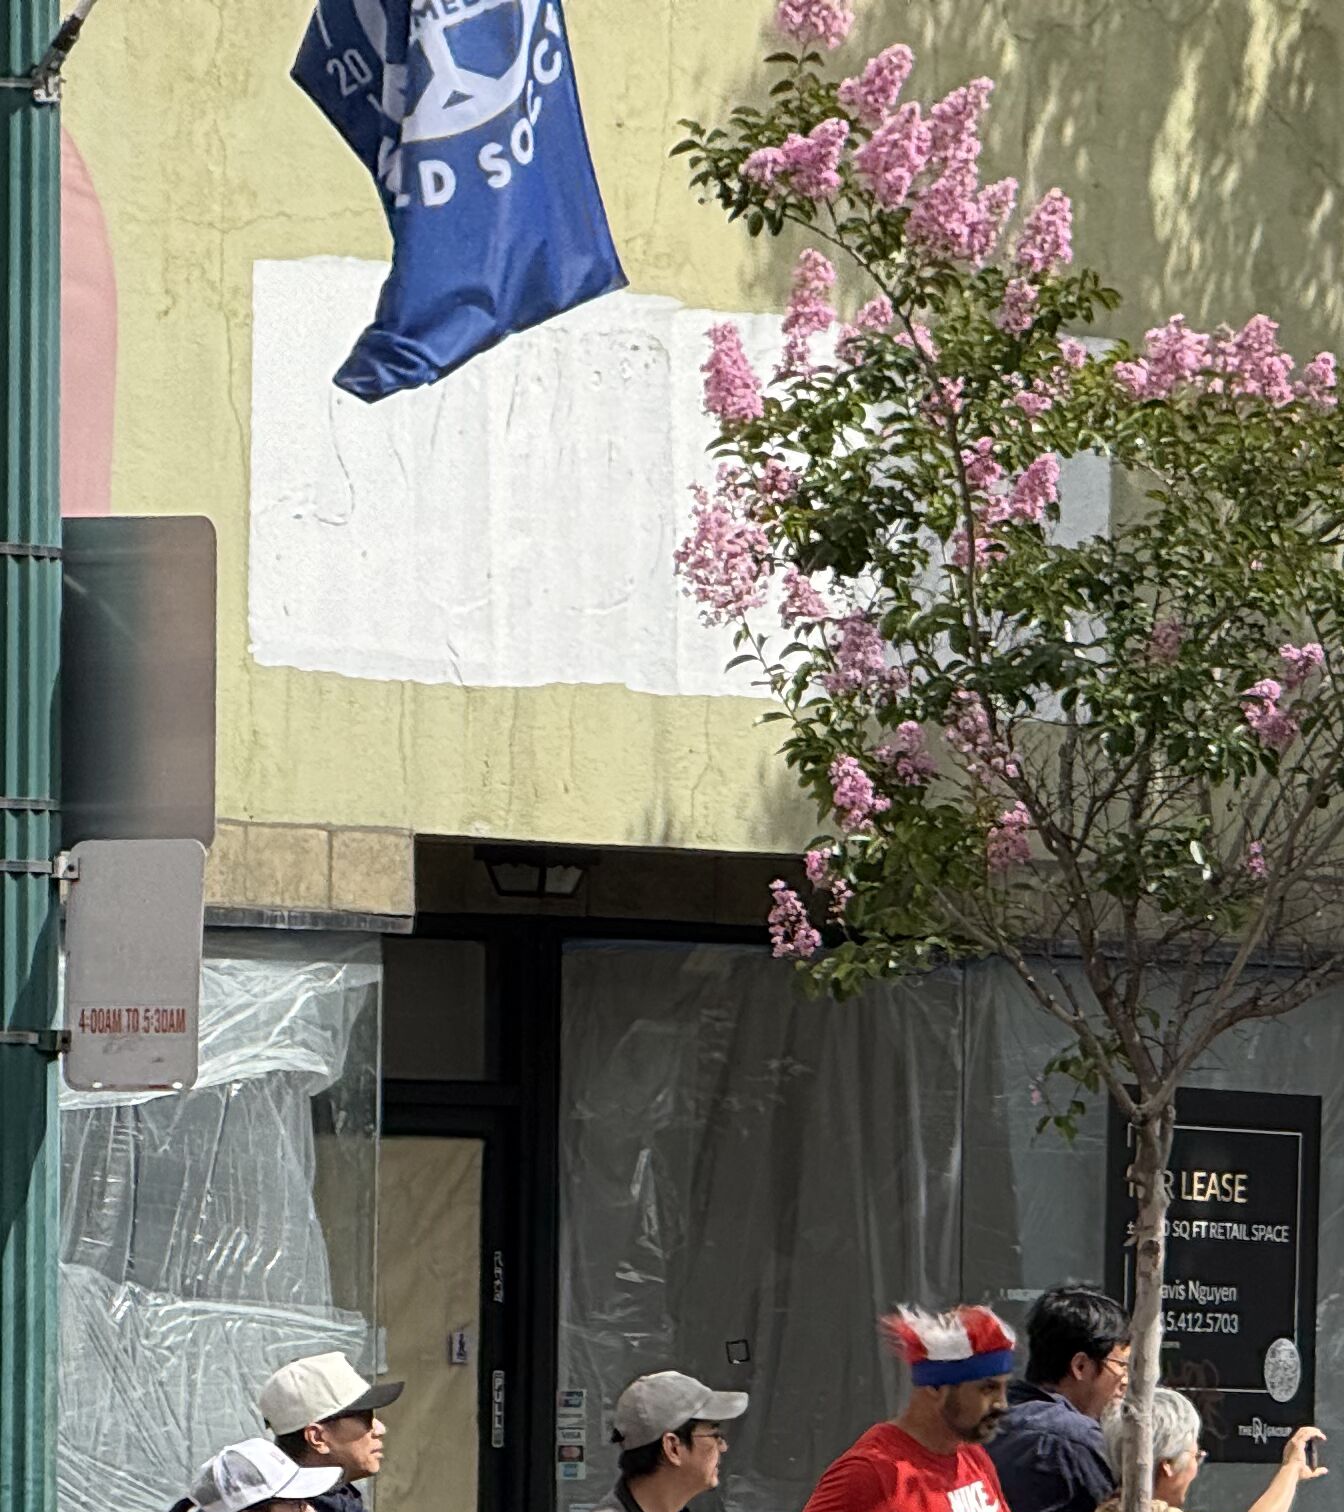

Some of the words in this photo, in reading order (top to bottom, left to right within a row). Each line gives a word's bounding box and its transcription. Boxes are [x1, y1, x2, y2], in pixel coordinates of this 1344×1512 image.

[327, 48, 373, 97] 20
[79, 1008, 122, 1034] 4:00AM
[125, 1008, 140, 1033] TO
[142, 1008, 186, 1034] 5:30AM
[1181, 1170, 1249, 1204] LEASE
[1172, 1220, 1191, 1241] SQ
[1192, 1221, 1209, 1239] FT
[1209, 1221, 1251, 1241] RETAIL
[1251, 1223, 1290, 1243] SPACE
[1188, 1280, 1237, 1306] Nguyen
